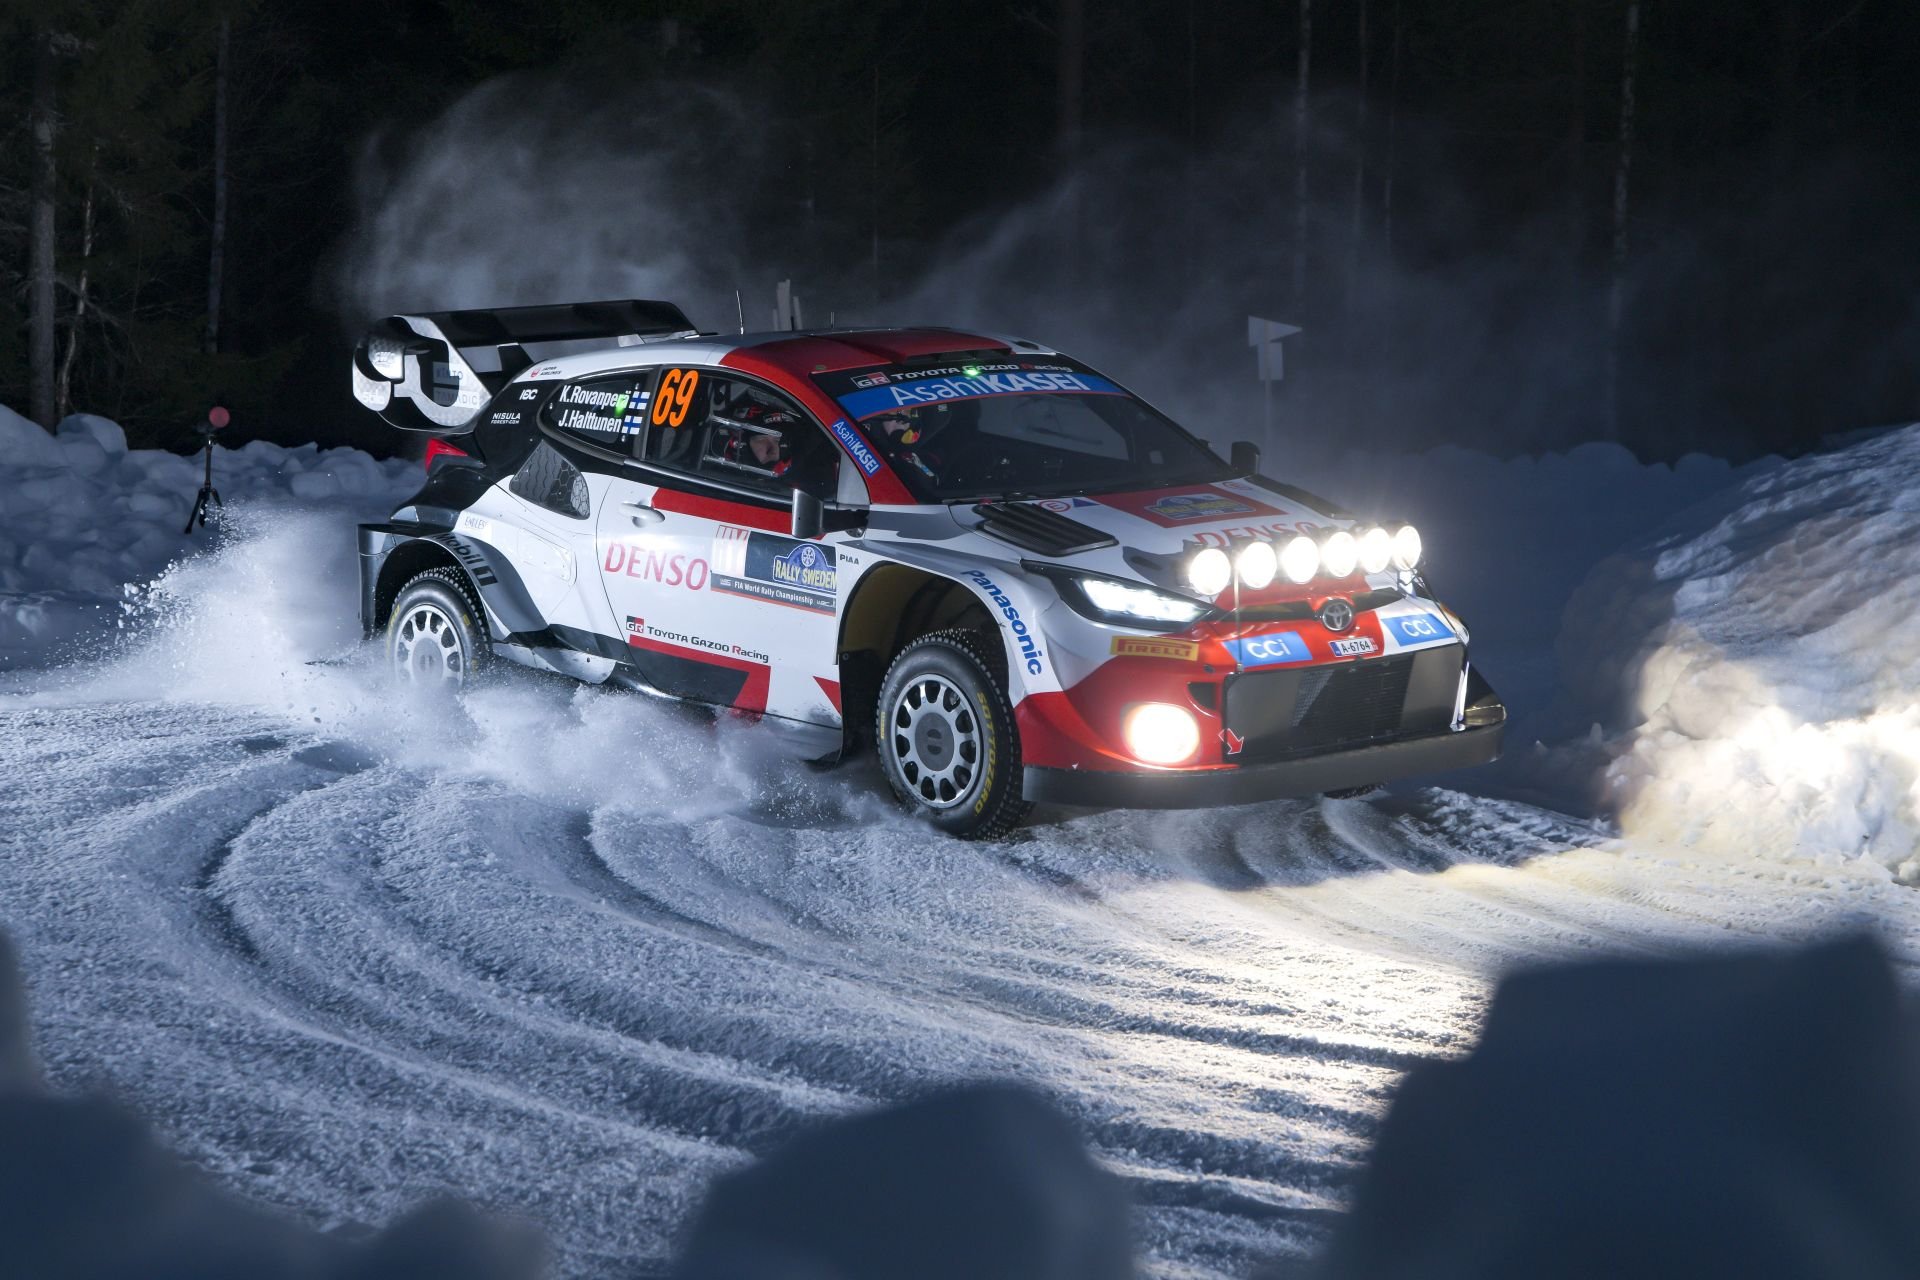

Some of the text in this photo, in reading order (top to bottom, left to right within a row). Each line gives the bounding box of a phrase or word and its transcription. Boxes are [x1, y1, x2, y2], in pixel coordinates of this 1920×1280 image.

[889, 373, 1091, 406] AsahiKASEI
[891, 367, 960, 380] TOYOTA
[559, 385, 632, 409] K.Rovanperä
[652, 368, 699, 427] 69
[558, 409, 622, 433] J.Halttunen
[833, 421, 880, 474] AsahiKASEI
[604, 541, 709, 591] DENSO
[775, 559, 837, 593] RALLY SWEDEN
[839, 554, 860, 565] PIAA
[734, 580, 744, 589] FIA
[745, 583, 760, 593] World
[761, 586, 775, 597] Rally
[775, 589, 814, 606] Championship
[961, 570, 1043, 675] Panasonic
[626, 619, 769, 663] GR TOYOTA GAZOO Racing
[1117, 639, 1193, 657] PIRELLI
[1341, 640, 1371, 652] A-6764
[975, 691, 996, 817] SOTTOZERO
